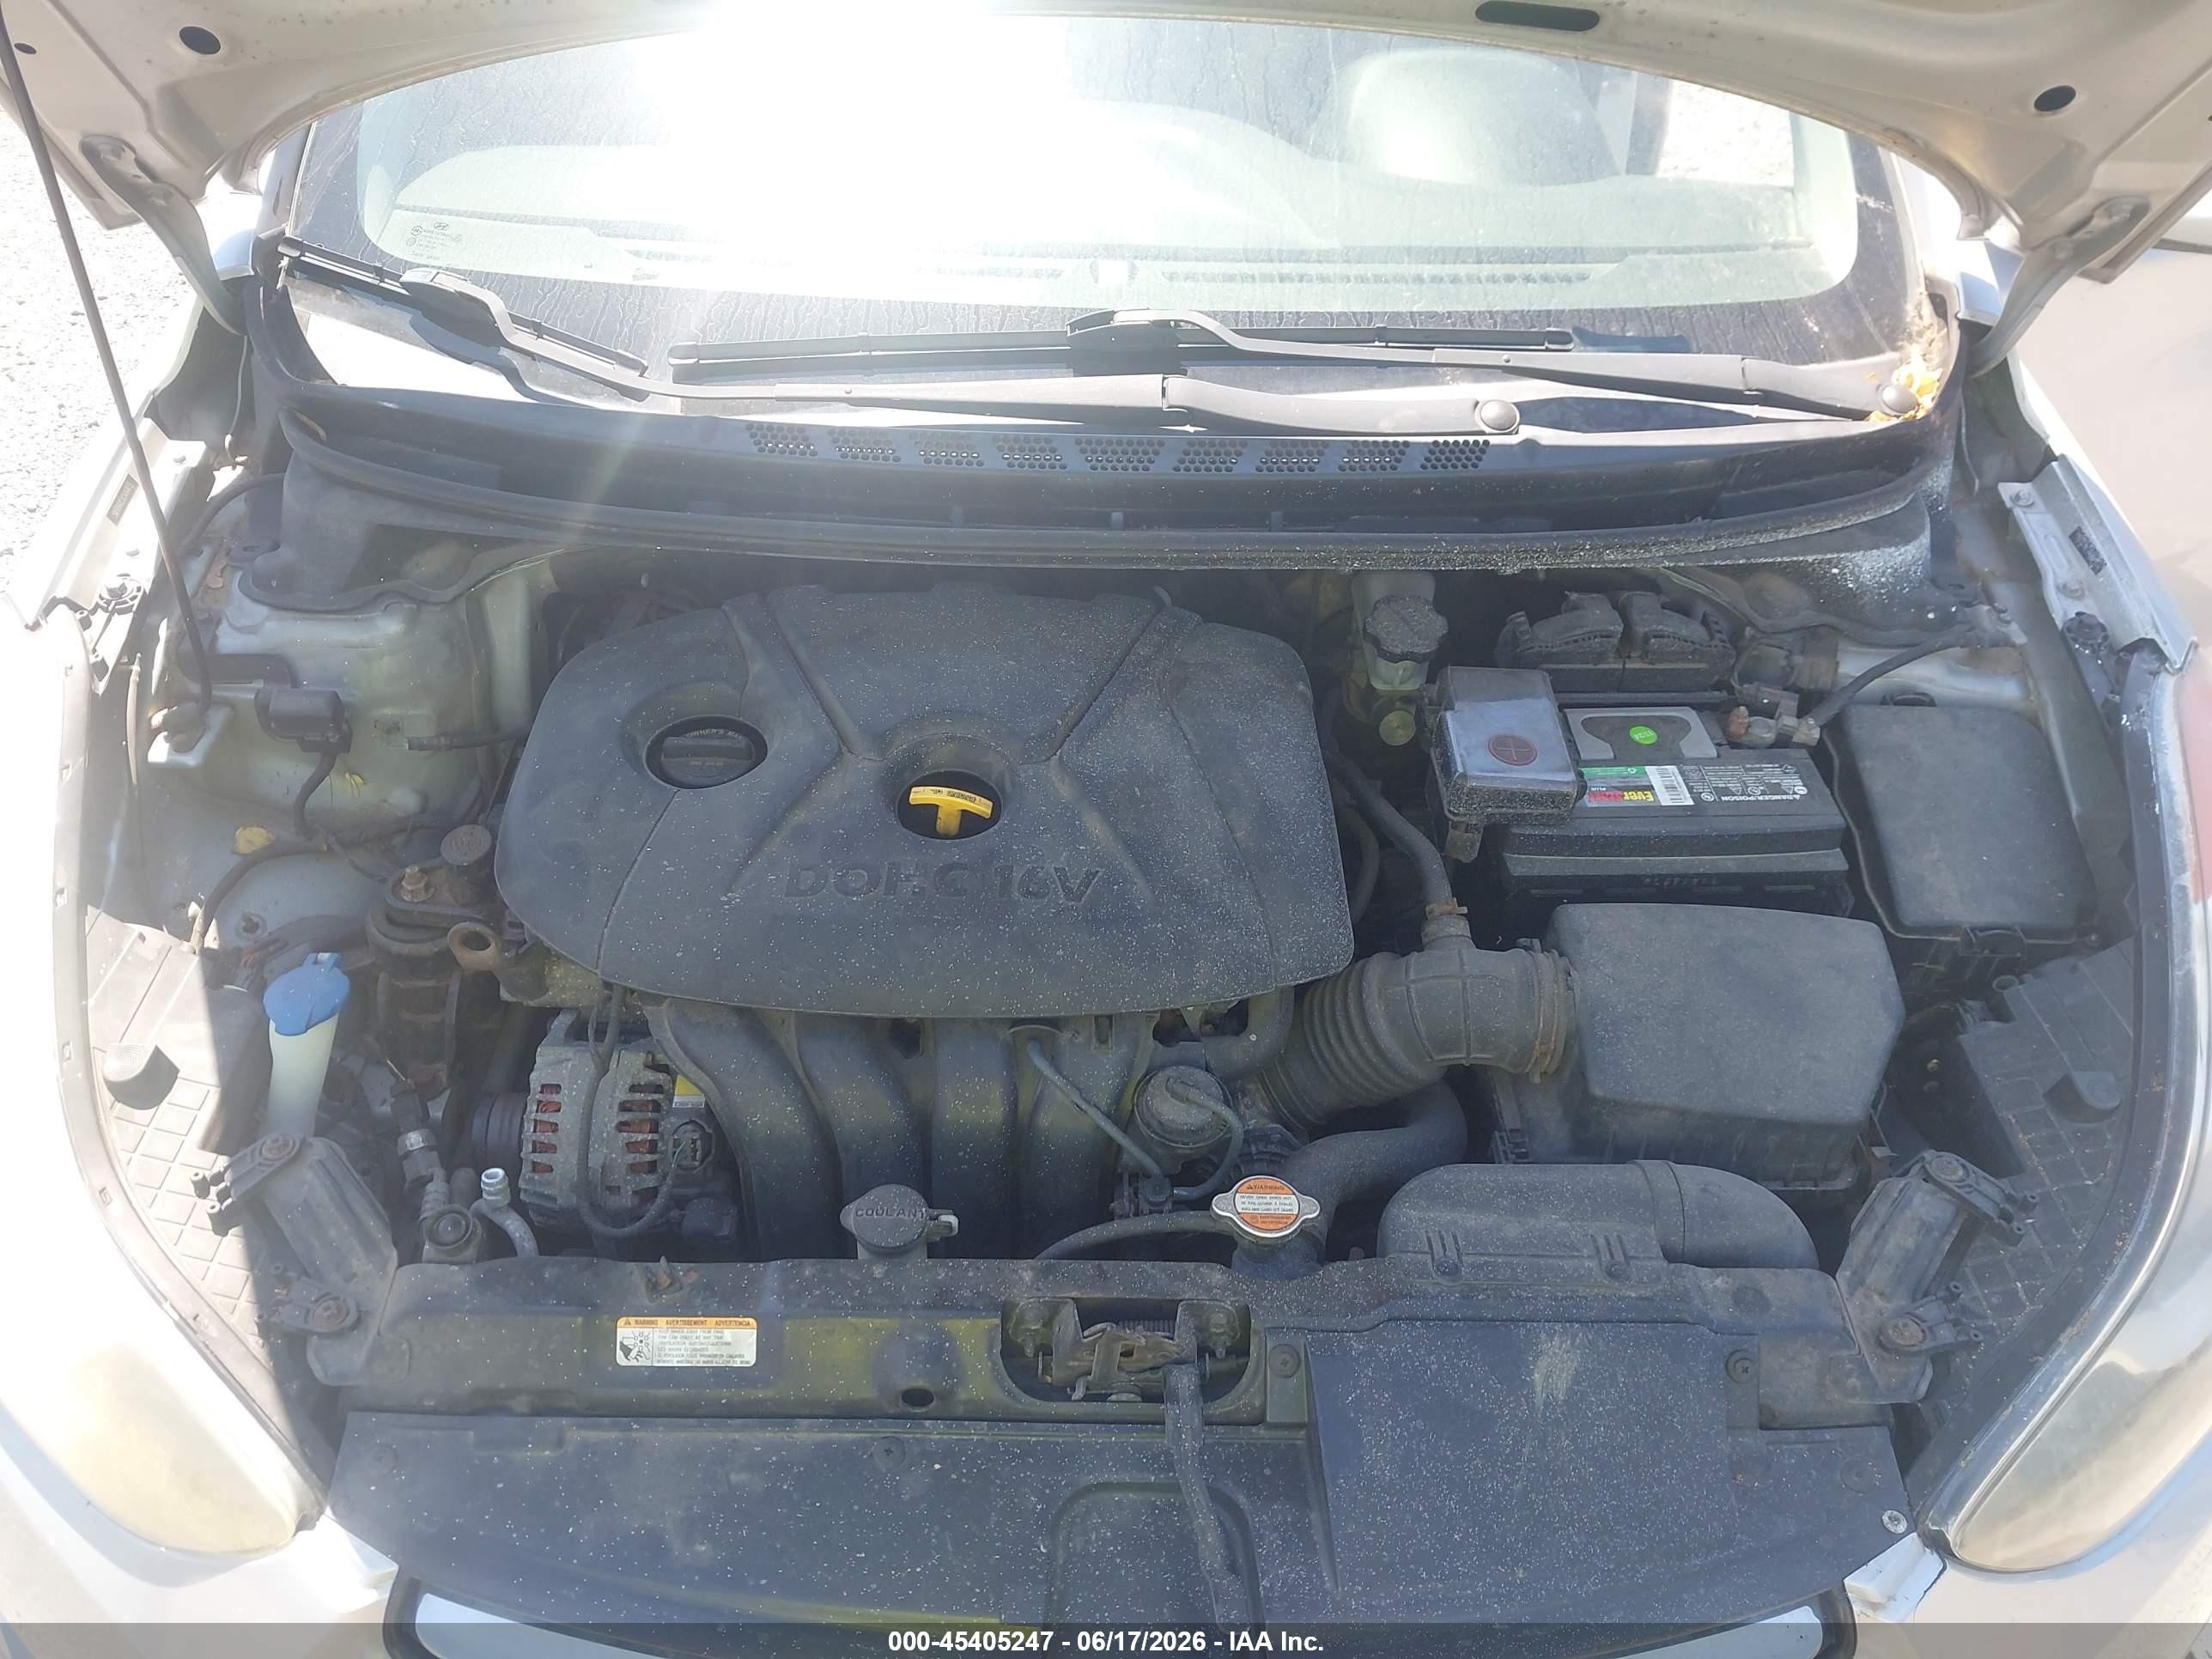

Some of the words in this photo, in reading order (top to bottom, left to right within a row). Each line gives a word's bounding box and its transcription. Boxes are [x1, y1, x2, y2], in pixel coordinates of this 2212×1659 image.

[783, 861, 969, 899] DOHC
[994, 863, 1103, 905] 16V
[855, 1208, 925, 1218] COOLANT
